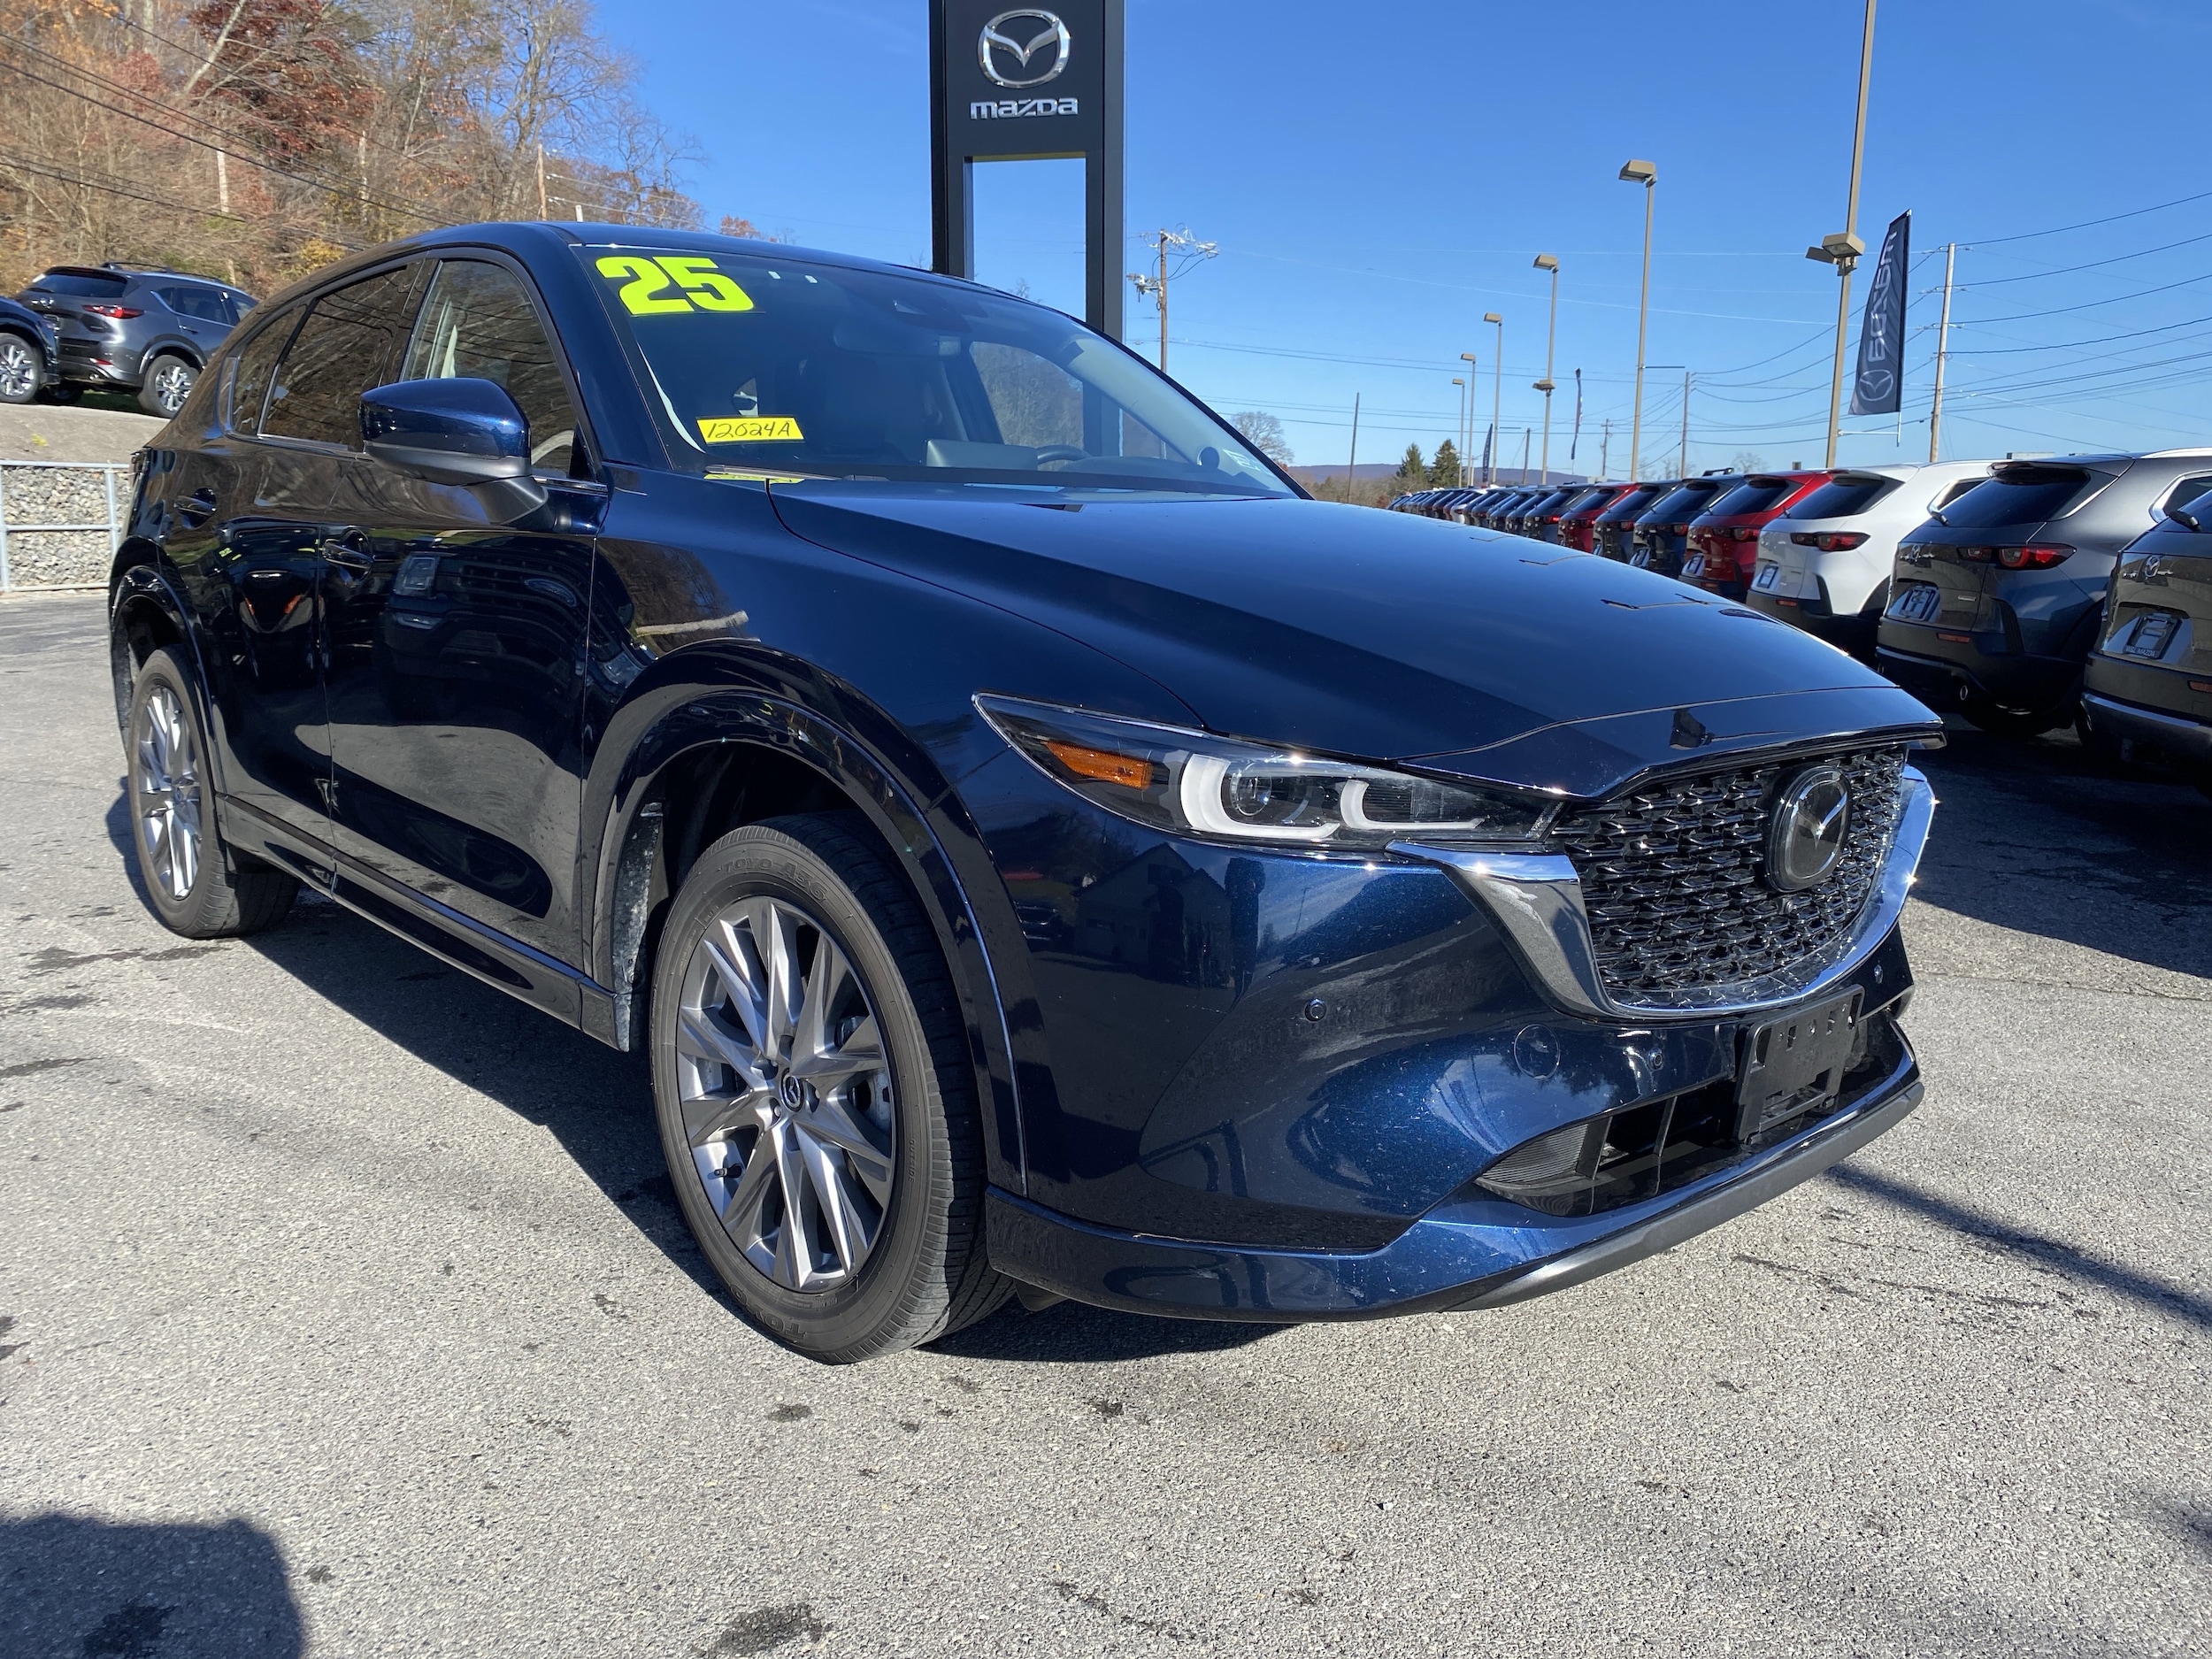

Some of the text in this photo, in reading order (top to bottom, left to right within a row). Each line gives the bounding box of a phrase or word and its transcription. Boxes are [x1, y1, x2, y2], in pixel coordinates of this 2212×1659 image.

[595, 257, 754, 314] 25
[707, 420, 792, 439] 12024A
[722, 857, 773, 873] TOYO
[730, 1285, 807, 1339] TOYO
